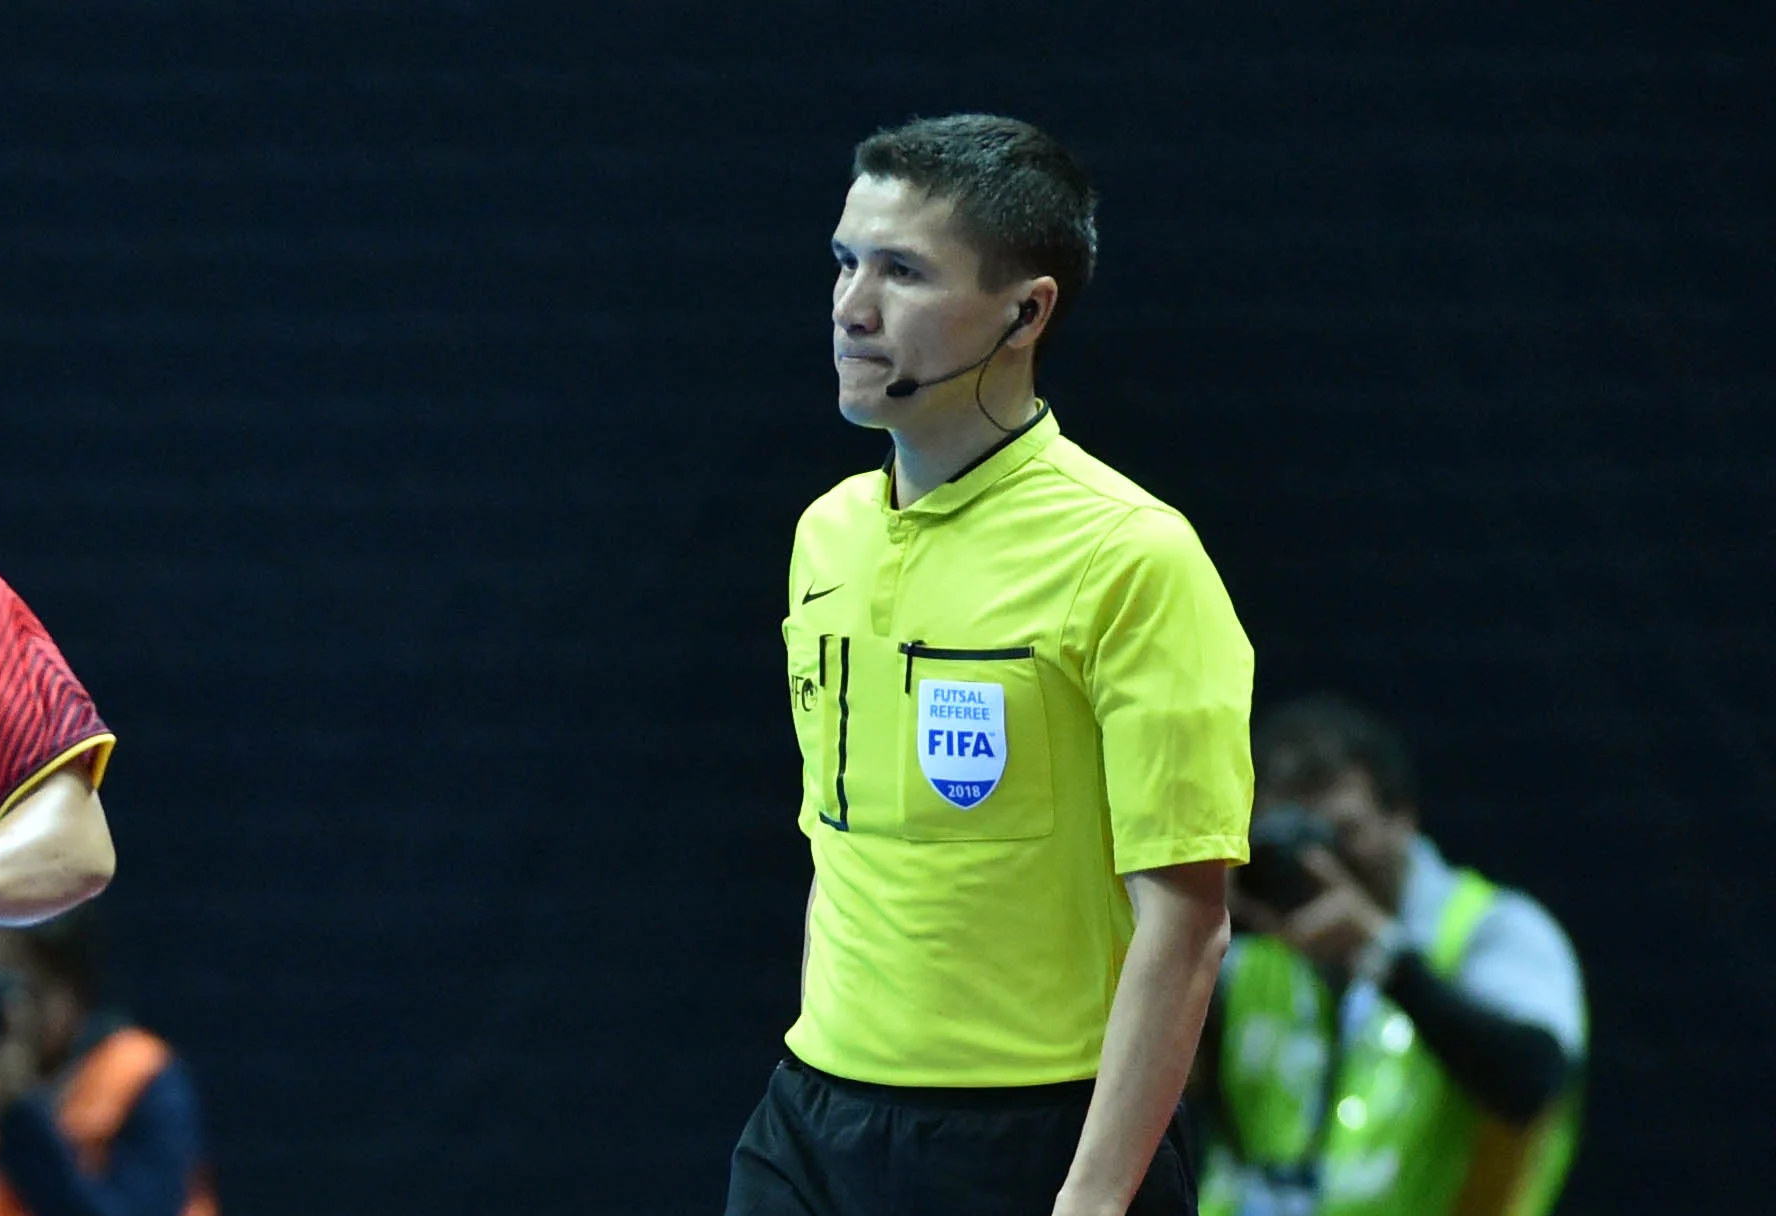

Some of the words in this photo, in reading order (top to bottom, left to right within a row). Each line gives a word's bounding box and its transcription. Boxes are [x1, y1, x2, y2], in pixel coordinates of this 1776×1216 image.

[933, 688, 986, 704] FUTSAL
[930, 704, 990, 720] REFEREE
[928, 729, 995, 757] FIFA
[948, 784, 981, 798] 2018
